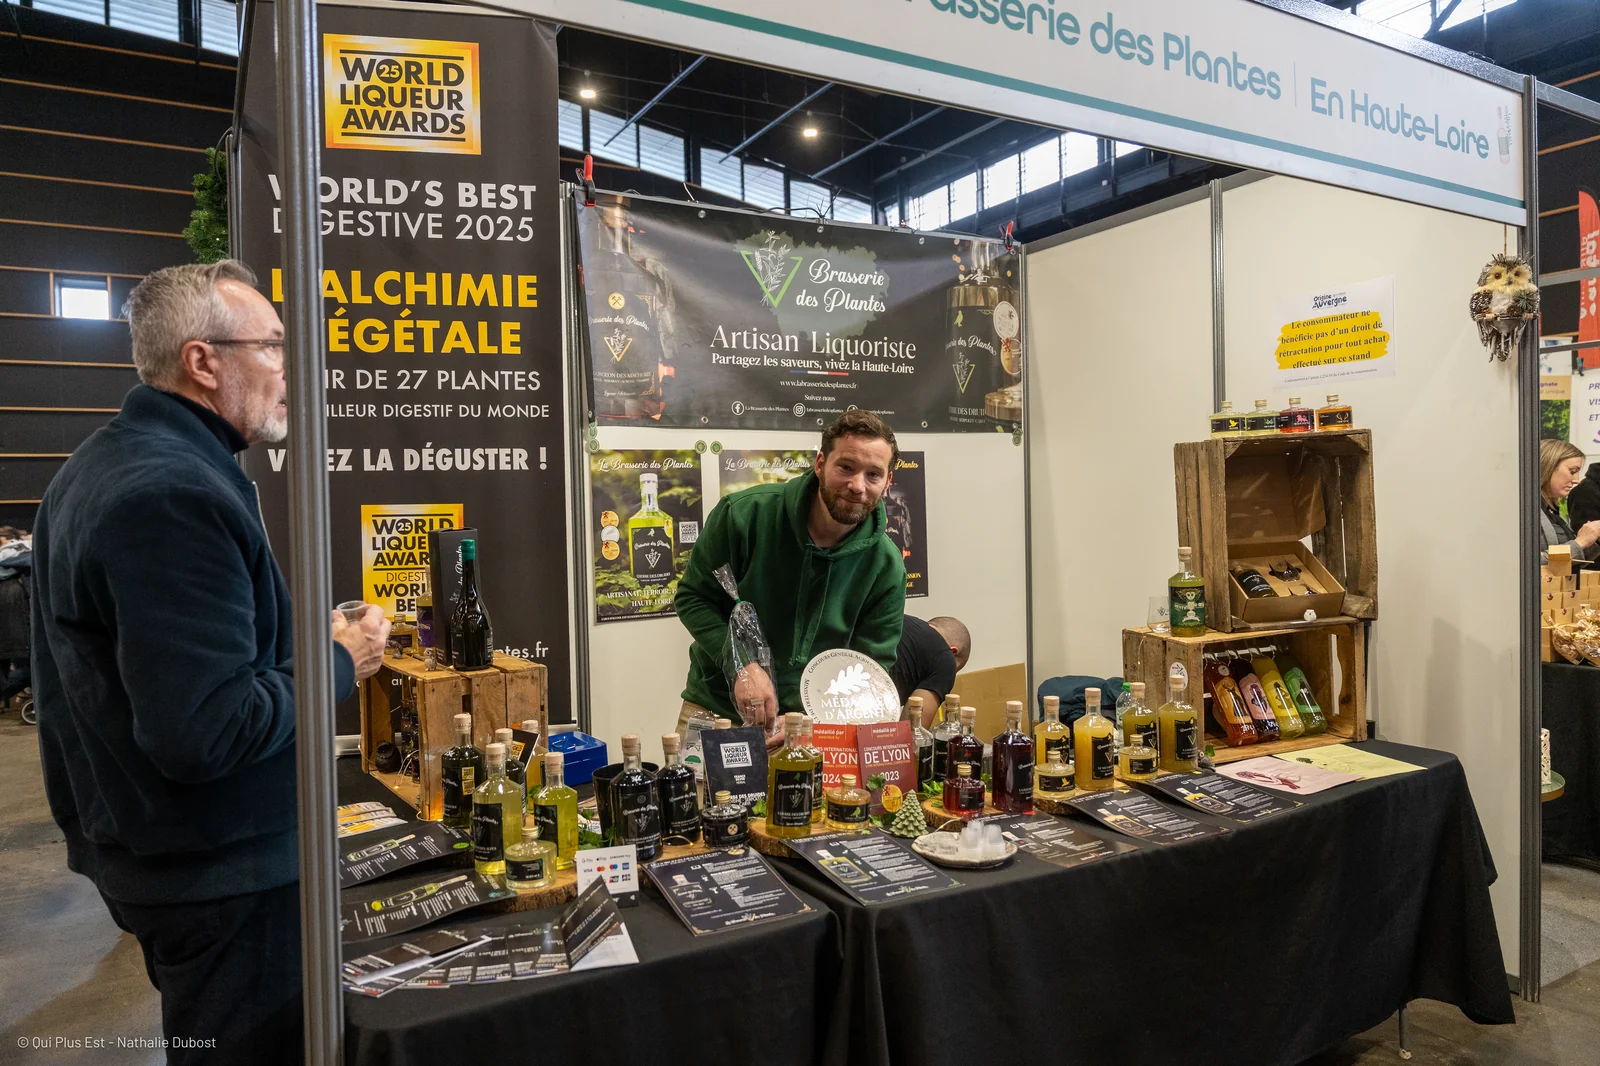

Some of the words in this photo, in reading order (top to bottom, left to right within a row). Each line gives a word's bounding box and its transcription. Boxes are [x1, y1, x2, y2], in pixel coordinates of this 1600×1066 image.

[339, 56, 465, 87] WORLD
[379, 63, 400, 78] 25
[1090, 12, 1154, 66] des
[1163, 32, 1281, 100] Plantes
[1310, 76, 1344, 119] En
[1351, 89, 1490, 159] Haute-Loire
[339, 84, 465, 111] LIQUEUR
[341, 108, 466, 135] AWARDS
[458, 182, 537, 210] BEST
[273, 207, 443, 239] GESTIVE
[455, 213, 534, 242] 2025
[808, 258, 885, 287] Brasserie
[271, 268, 538, 308] LALCHIMIE
[795, 289, 819, 308] des
[823, 287, 886, 313] Plantes
[1311, 294, 1348, 310] Auvergne
[1313, 293, 1332, 303] Origine
[613, 315, 625, 325] des
[1291, 320, 1301, 329] Le
[1302, 311, 1360, 327] consommateur
[1361, 309, 1371, 317] ne
[326, 307, 521, 355] ÉGÉTALE
[1281, 332, 1314, 344] bénéficie
[1315, 331, 1329, 341] pas
[1330, 326, 1349, 337] d'un
[1351, 322, 1371, 333] droit
[1372, 321, 1383, 330] de
[709, 325, 800, 353] Artisan
[811, 331, 917, 361] Liquoriste
[968, 334, 997, 356] Plantes
[1279, 345, 1323, 358] rétractation
[1324, 342, 1344, 353] pour
[1345, 337, 1362, 348] tout
[1363, 335, 1387, 346] achat
[711, 353, 761, 369] Partagez
[763, 354, 779, 368] les
[780, 357, 822, 370] saveurs,
[825, 359, 850, 370] vivez
[852, 359, 861, 371] la
[862, 360, 915, 374] Haute-Loire
[1292, 357, 1322, 369] effectué
[1323, 357, 1337, 365] sur
[1338, 355, 1347, 363] ce
[1348, 350, 1371, 361] stand
[355, 369, 388, 390] DE
[396, 369, 428, 390] 27
[436, 370, 541, 392] PLANTES
[326, 403, 377, 418] ILLEUR
[382, 403, 454, 419] DIGESTIF
[458, 404, 482, 419] DU
[487, 404, 550, 419] MONDE
[267, 448, 353, 472] VEZ
[363, 448, 394, 472] LA
[403, 441, 529, 472] DÉGUSTER
[538, 446, 548, 470] !
[597, 459, 609, 472] La
[610, 459, 649, 470] Brasserie
[650, 460, 662, 469] des
[662, 457, 694, 470] Plantes
[724, 458, 736, 471] La
[736, 457, 771, 470] Brasserie
[772, 457, 783, 469] des
[784, 457, 811, 470] Plantes
[894, 458, 919, 471] Plantes
[396, 521, 412, 531] 25
[371, 536, 427, 551] LIQUE
[372, 552, 431, 567] AWAR
[386, 571, 426, 582] DIGEST
[395, 598, 416, 613] BE
[723, 746, 747, 754] WORLD
[823, 752, 858, 765] LYON
[864, 751, 880, 765] DE
[881, 748, 911, 763] LYON
[822, 773, 841, 784] 024
